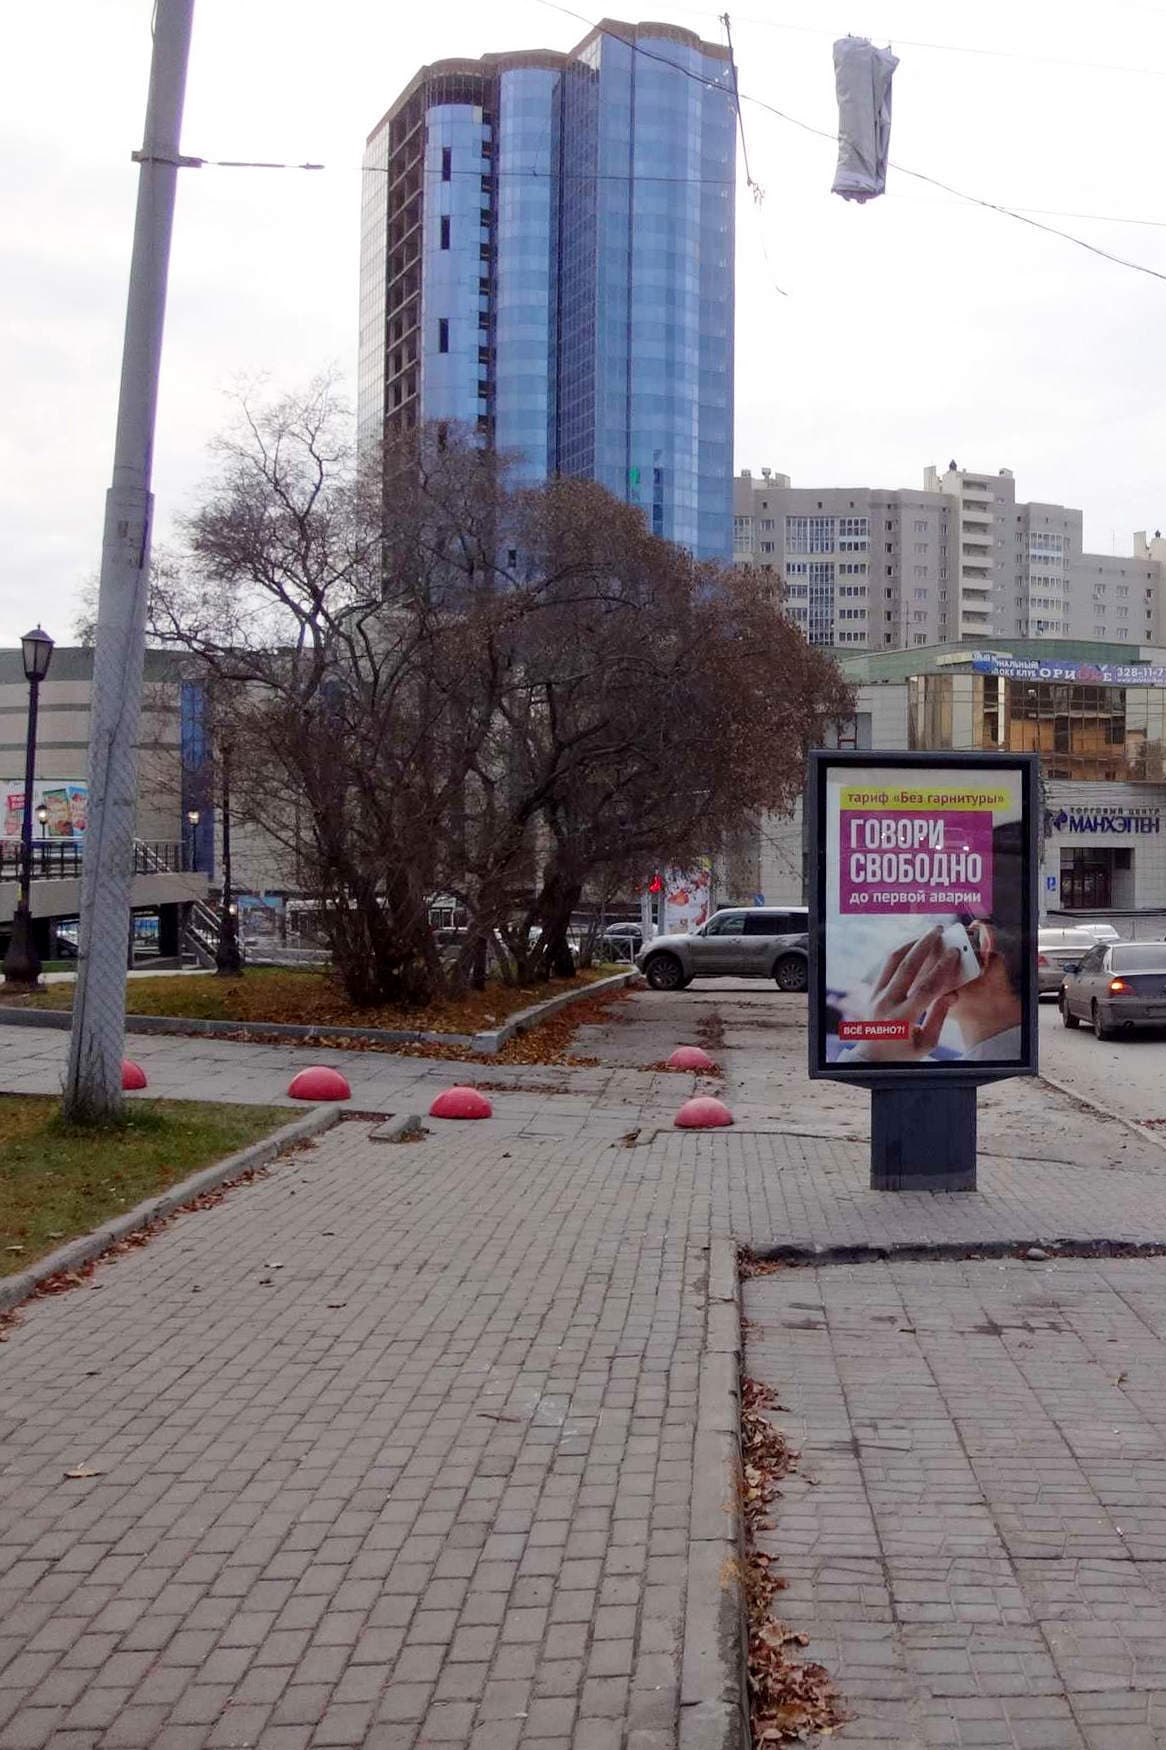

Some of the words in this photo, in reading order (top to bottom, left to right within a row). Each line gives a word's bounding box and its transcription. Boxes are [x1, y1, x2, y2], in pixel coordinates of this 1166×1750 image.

[848, 791, 889, 806] тариф
[894, 791, 923, 804] «Без
[927, 794, 1004, 807] гарнитуры»
[850, 819, 944, 849] ГОВОРИ
[850, 852, 982, 886] СВОБОДНО
[849, 892, 869, 904] до
[873, 889, 926, 905] первой
[929, 892, 981, 905] аварии
